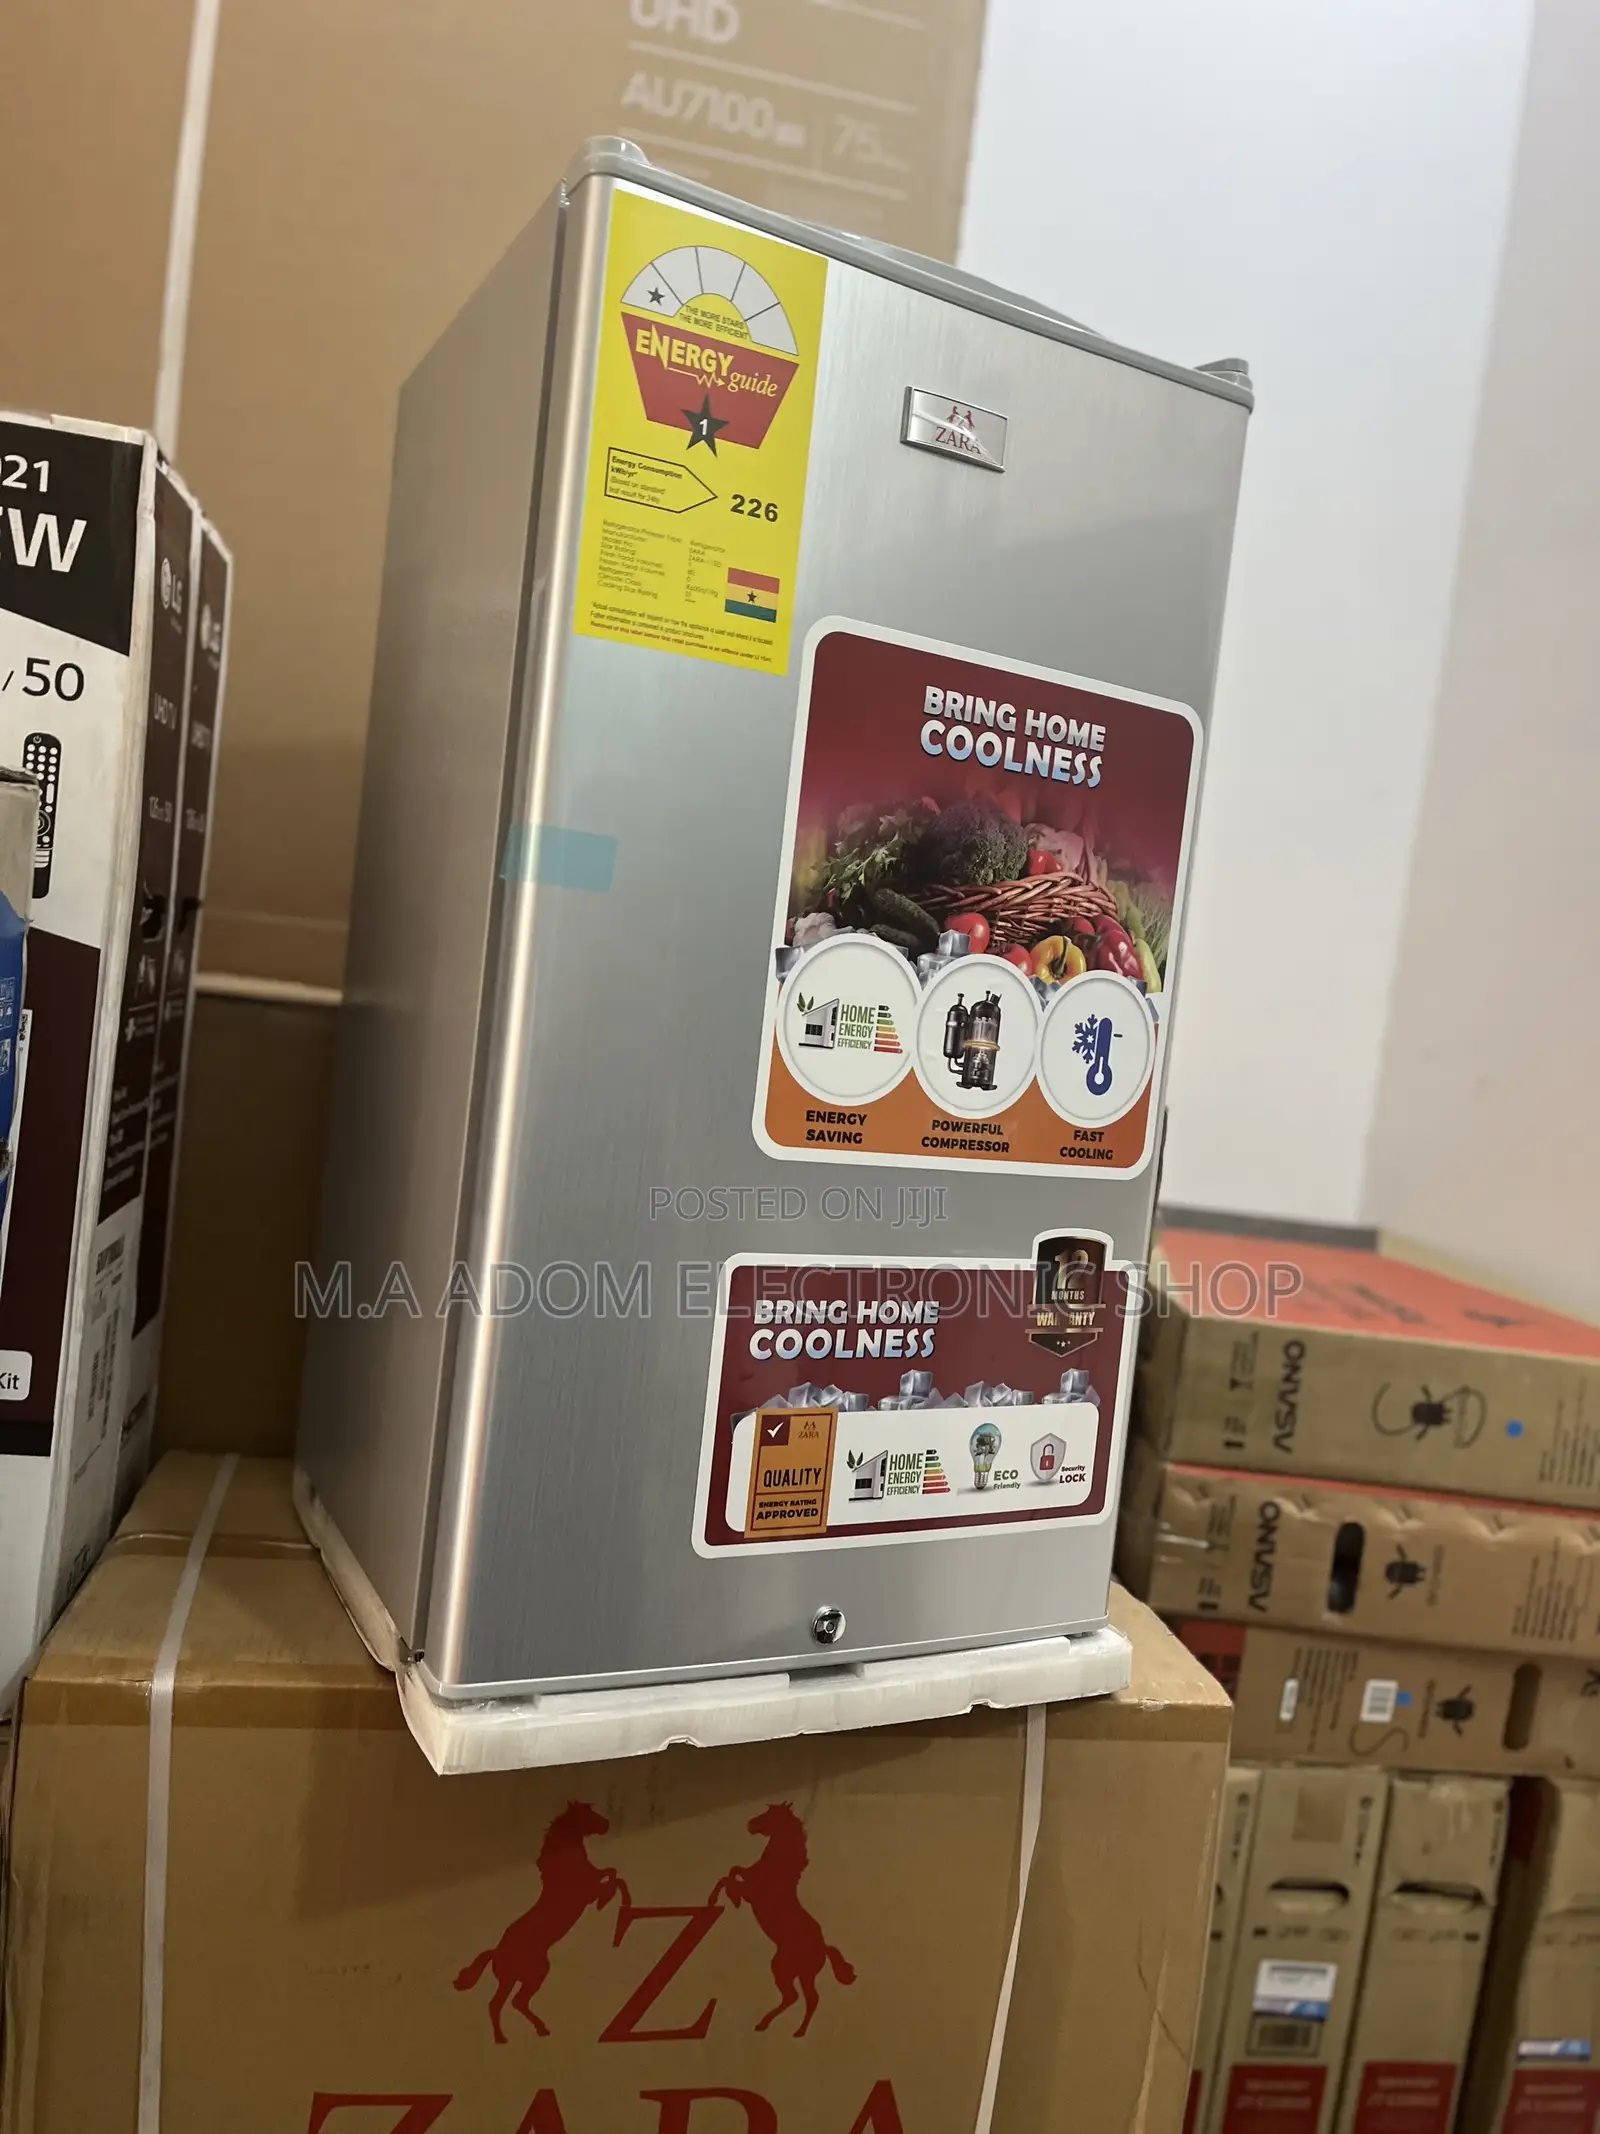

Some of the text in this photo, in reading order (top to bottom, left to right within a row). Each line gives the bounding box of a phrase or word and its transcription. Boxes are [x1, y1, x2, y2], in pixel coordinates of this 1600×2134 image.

[685, 305, 745, 329] THE MORE STARS
[635, 323, 734, 377] ENERGY
[727, 371, 778, 397] guide
[699, 418, 708, 436] 1
[0, 455, 50, 492] 21
[730, 494, 779, 523] 226
[0, 506, 87, 573] W
[22, 657, 84, 701] 50
[923, 685, 1106, 752] BRING HOME
[920, 719, 1103, 788] COOLNESS
[840, 1004, 876, 1024] HOME
[839, 1023, 873, 1038] ENERGY
[838, 1038, 872, 1050] EFFICIENCY
[806, 1110, 867, 1126] ENERGY
[931, 1119, 1004, 1136] POWERFUL
[1073, 1129, 1105, 1143] FAST
[805, 1129, 863, 1144] SAVING
[921, 1136, 1010, 1153] COMPRESSOR
[1059, 1146, 1114, 1161] COOLING
[1051, 1290, 1085, 1300] MONTHS
[754, 1300, 940, 1324] BRING HOME
[1037, 1311, 1096, 1326] WAANTY
[749, 1328, 936, 1360] COOLNESS
[889, 1453, 924, 1471] HOME
[1061, 1465, 1086, 1473] Security
[763, 1467, 822, 1487] QUALITY
[888, 1470, 922, 1485] ENERGY
[994, 1469, 1019, 1481] ECO
[1059, 1473, 1087, 1484] LOCK
[887, 1485, 920, 1496] EFFICIENCY
[993, 1482, 1021, 1490] Friendly
[759, 1499, 817, 1509] ENERGY RATING
[756, 1508, 819, 1521] APPROVED
[597, 1906, 725, 2042] Z
